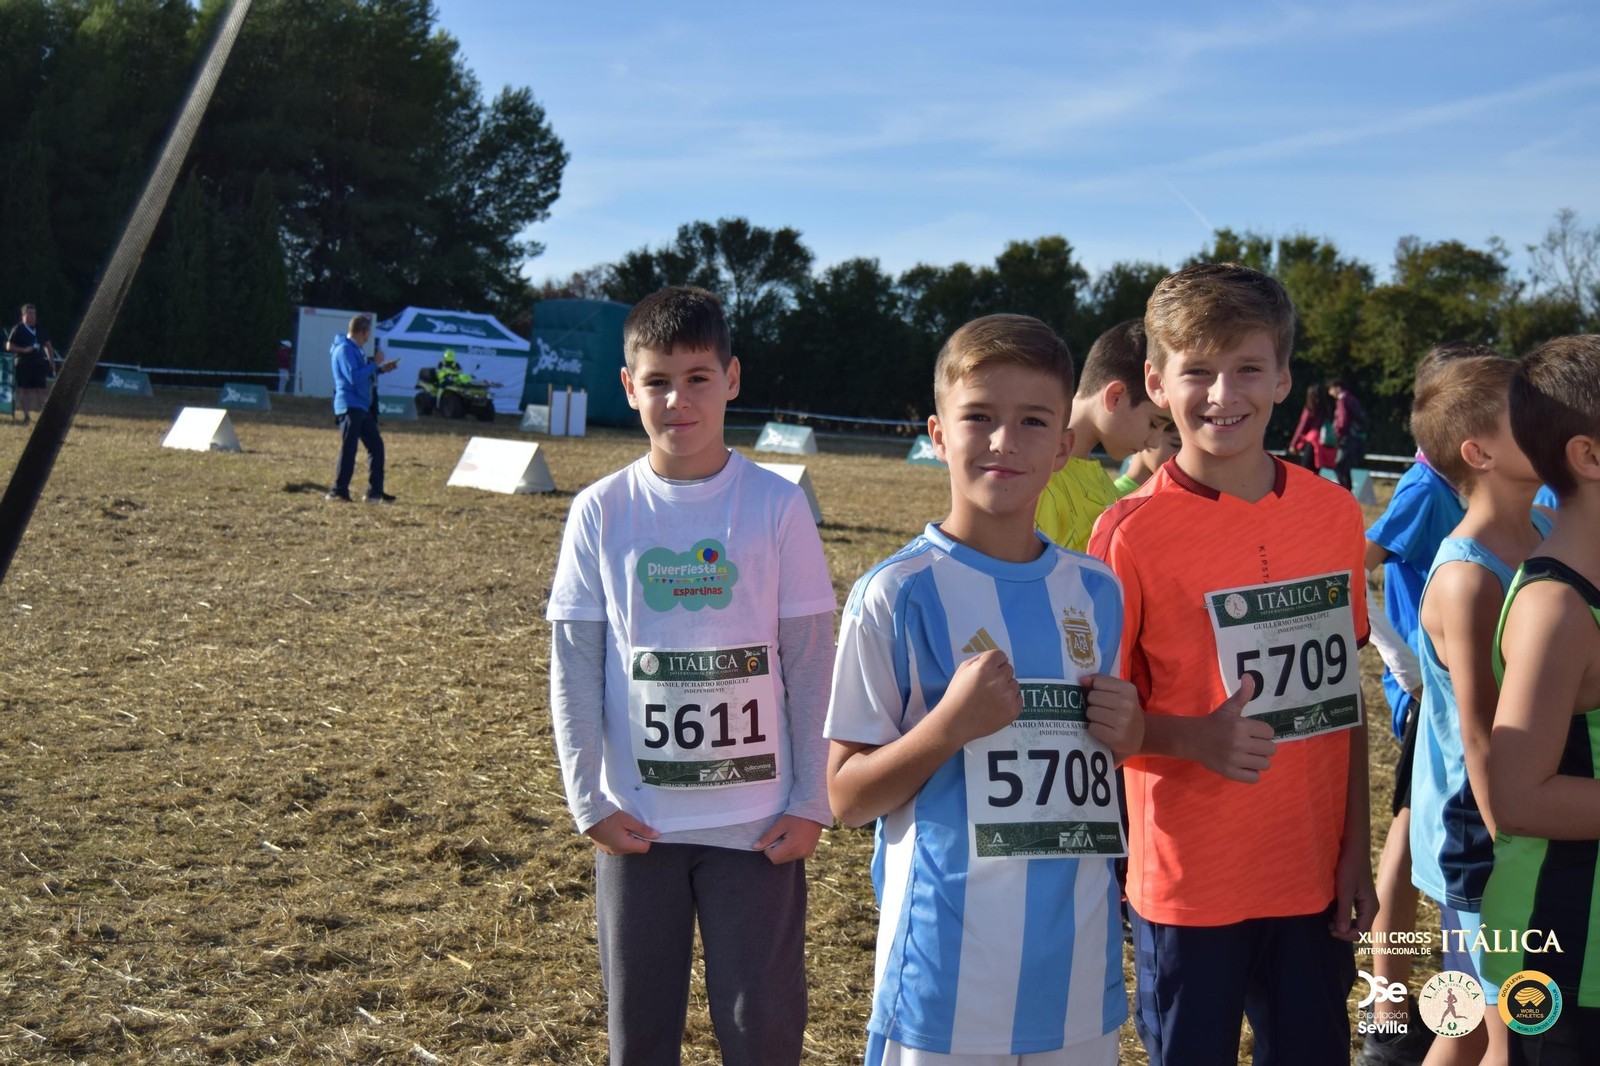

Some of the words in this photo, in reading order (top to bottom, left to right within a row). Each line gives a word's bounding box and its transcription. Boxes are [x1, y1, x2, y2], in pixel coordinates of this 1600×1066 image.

[1257, 585, 1322, 611] ITÁLICA
[1253, 619, 1292, 630] GUILLERMO
[1292, 615, 1315, 625] MOLINA
[1314, 611, 1330, 621] LÓPEZ
[1277, 623, 1313, 634] INDEPENDIENTE
[669, 652, 739, 671] ITÁLICA
[1236, 633, 1347, 702] 5709
[715, 677, 750, 687] RODRÍGUEZ
[1019, 684, 1087, 709] ITÁLICA
[644, 698, 766, 750] 5611
[1010, 721, 1037, 729] MARIO
[1037, 721, 1070, 729] MACHUCA
[987, 749, 1112, 808] 5708
